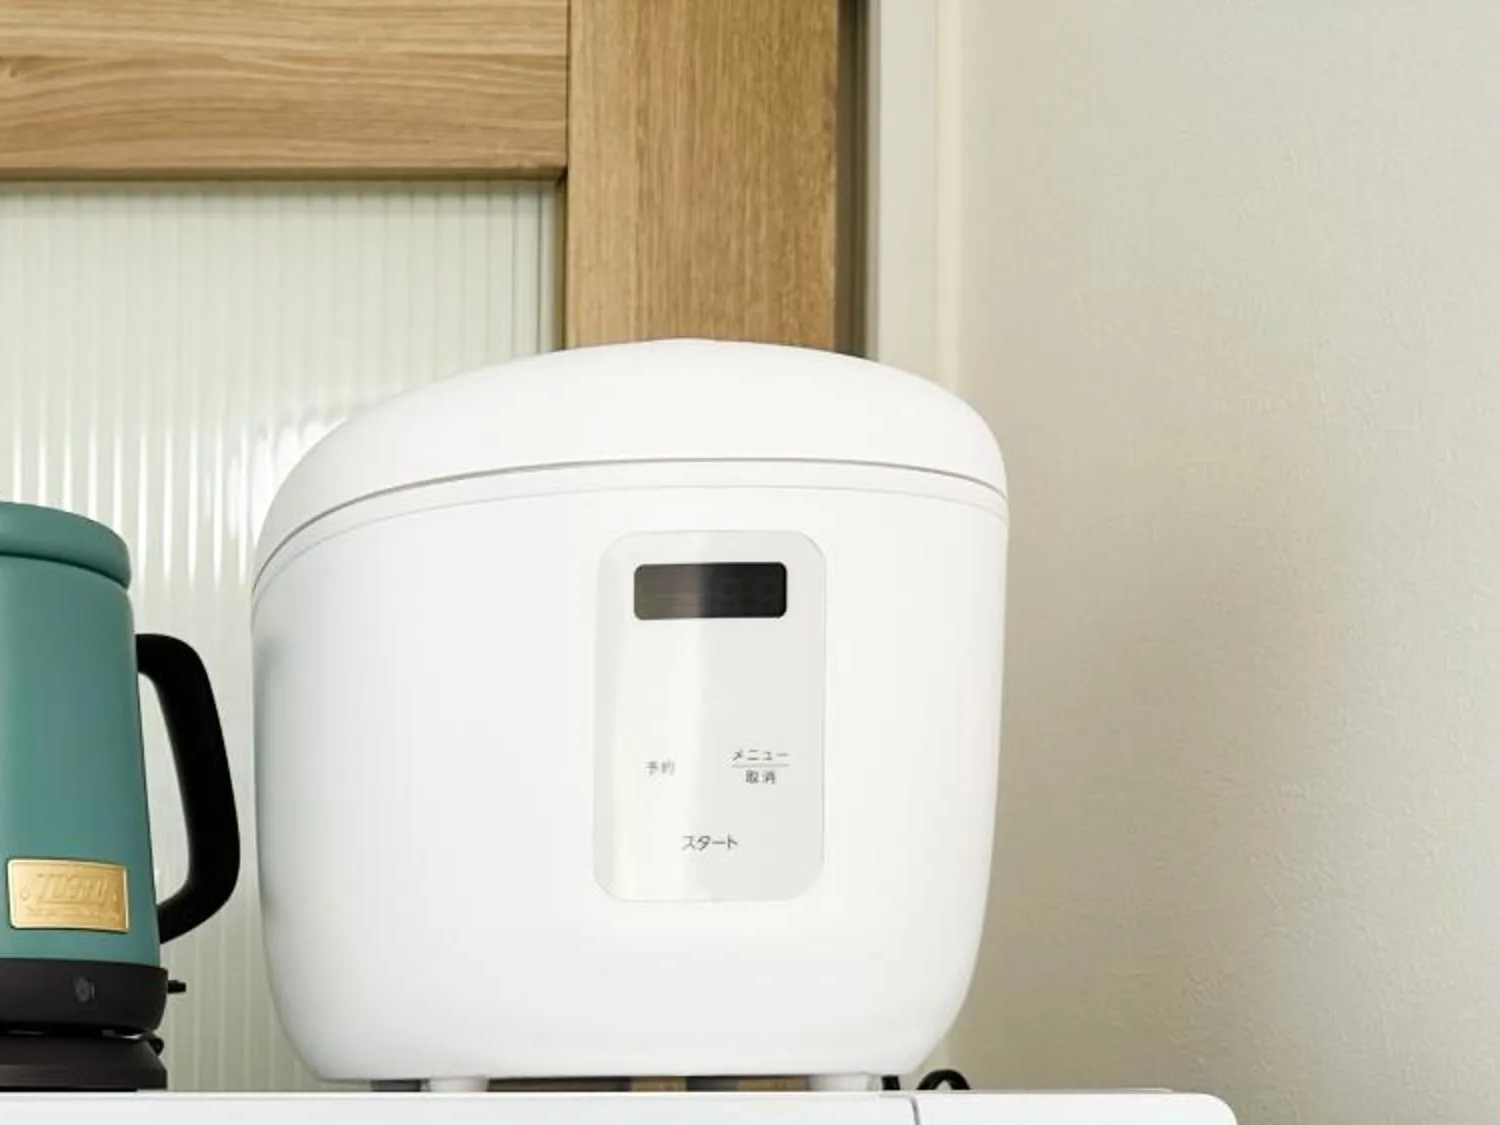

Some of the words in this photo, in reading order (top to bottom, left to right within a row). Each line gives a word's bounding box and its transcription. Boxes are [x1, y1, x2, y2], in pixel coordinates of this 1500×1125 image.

[731, 749, 789, 762] メニュー
[745, 770, 776, 784] 取消
[681, 834, 739, 851] スタート
